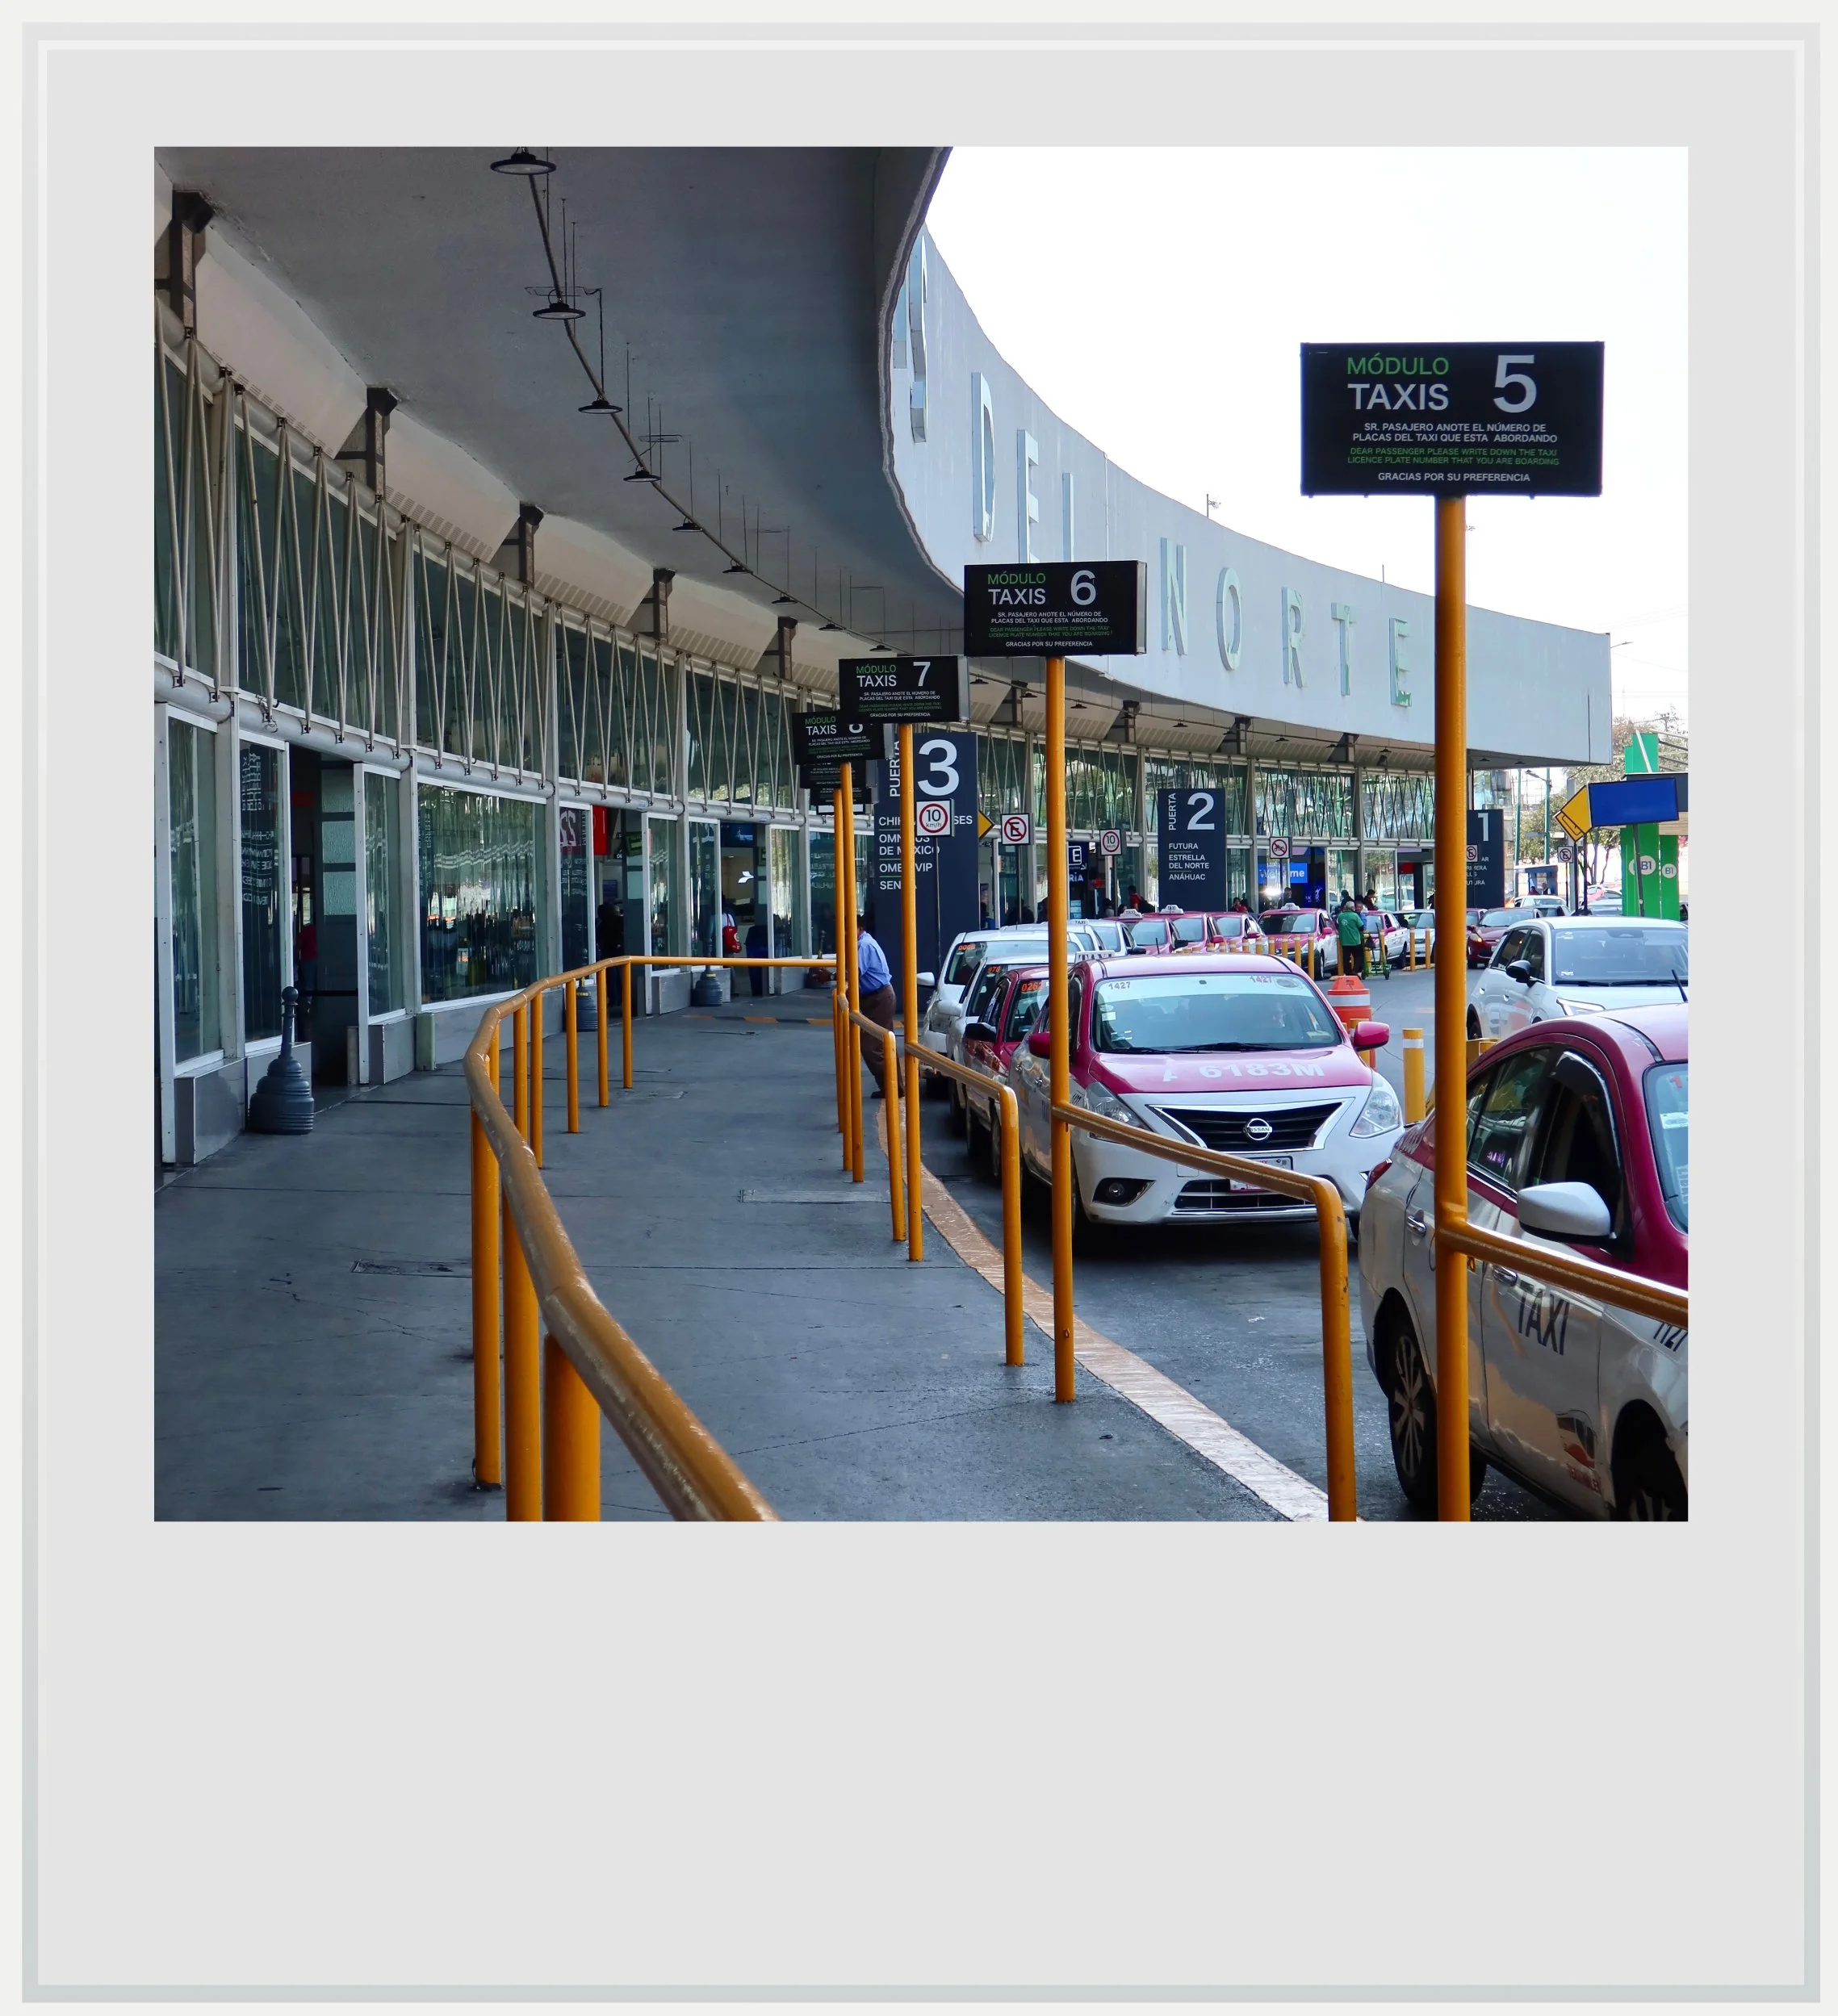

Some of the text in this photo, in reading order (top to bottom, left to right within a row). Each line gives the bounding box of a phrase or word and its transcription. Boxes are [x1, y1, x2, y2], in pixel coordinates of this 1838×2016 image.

[1347, 353, 1449, 374] MÓDULO
[1493, 354, 1537, 413] 5
[1347, 383, 1449, 410] TAXIS
[1364, 422, 1547, 432] SR. PASAJERO ANOTE EL NÚMERO DE
[1353, 433, 1558, 443] PLACAS DEL TAXI QUE ESTA ABORDANDO
[1378, 473, 1530, 482] GRACIAS POR SU PREFERENCIA
[987, 571, 1046, 584] MÓDULO
[1070, 570, 1096, 605] 6
[988, 588, 1046, 605] TAXIS
[1161, 537, 1413, 708] NORTE
[856, 663, 896, 674] MÓDULO
[913, 661, 931, 686] 7
[856, 675, 897, 687] TAXIS
[805, 717, 836, 725] MÓDULO
[806, 725, 837, 736] TAXIS
[917, 739, 960, 796] 3
[926, 809, 941, 822] 10
[1169, 793, 1177, 830] PUERTA
[1187, 792, 1215, 830] 2
[1478, 813, 1489, 842] 1
[1106, 835, 1116, 843] 10
[879, 846, 894, 855] DE
[915, 863, 933, 872] VIP
[1169, 872, 1206, 880] ANÁHUAC
[1108, 981, 1131, 990] 1427
[1199, 1063, 1325, 1079] 6183M
[1518, 1280, 1570, 1356] TAXI
